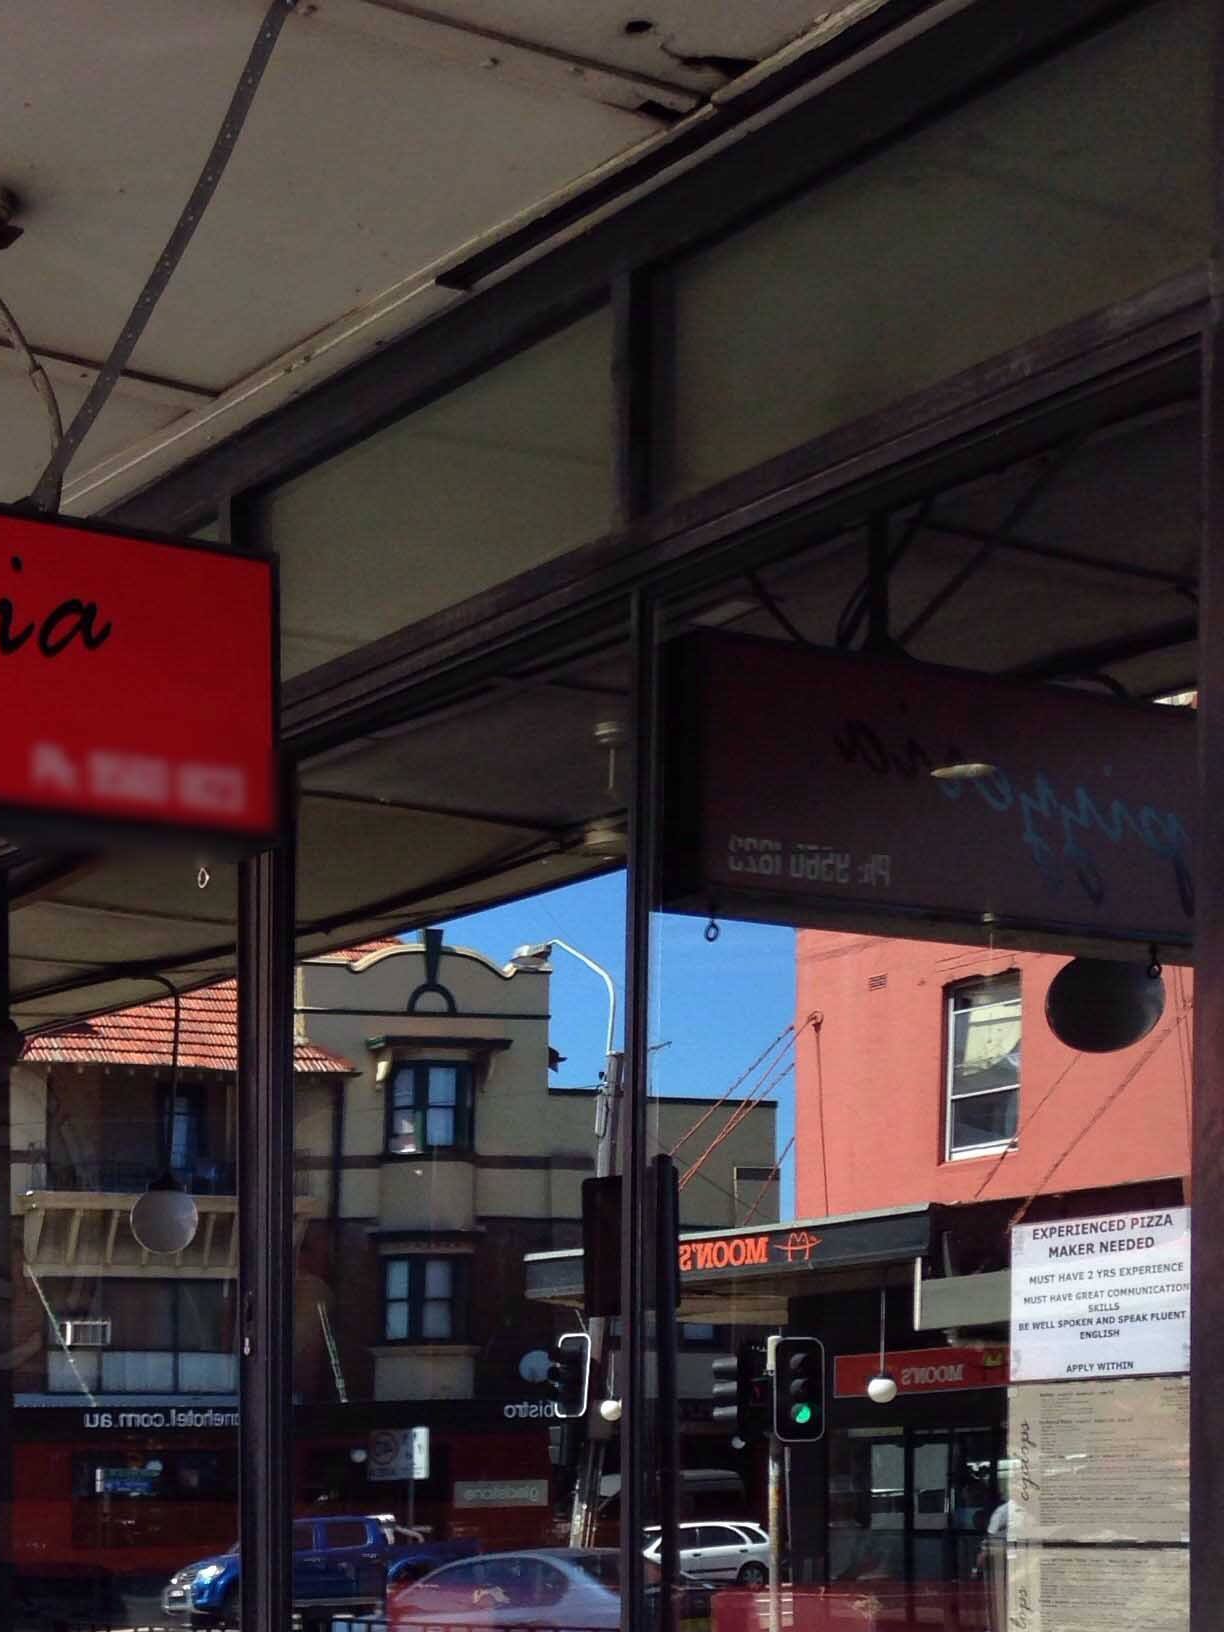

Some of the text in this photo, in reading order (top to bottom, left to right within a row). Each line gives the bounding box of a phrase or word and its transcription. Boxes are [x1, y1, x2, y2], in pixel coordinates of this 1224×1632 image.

[1032, 1213, 1174, 1241] EXPERIENCED PIZZA
[1048, 1236, 1155, 1259] MAKER NEEDED
[1029, 1262, 1184, 1285] MUST HAVE 2 YRS EXPERIENCE
[1023, 1282, 1190, 1305] MUST HAVE GREAT COMMUNICATION
[1088, 1302, 1120, 1313] SKILLS
[1018, 1310, 1187, 1331] BE WELL SPOKEN AND SPEAK FLUENT
[1079, 1329, 1120, 1340] ENGLISH
[1066, 1360, 1134, 1373] APPLY WITHIN
